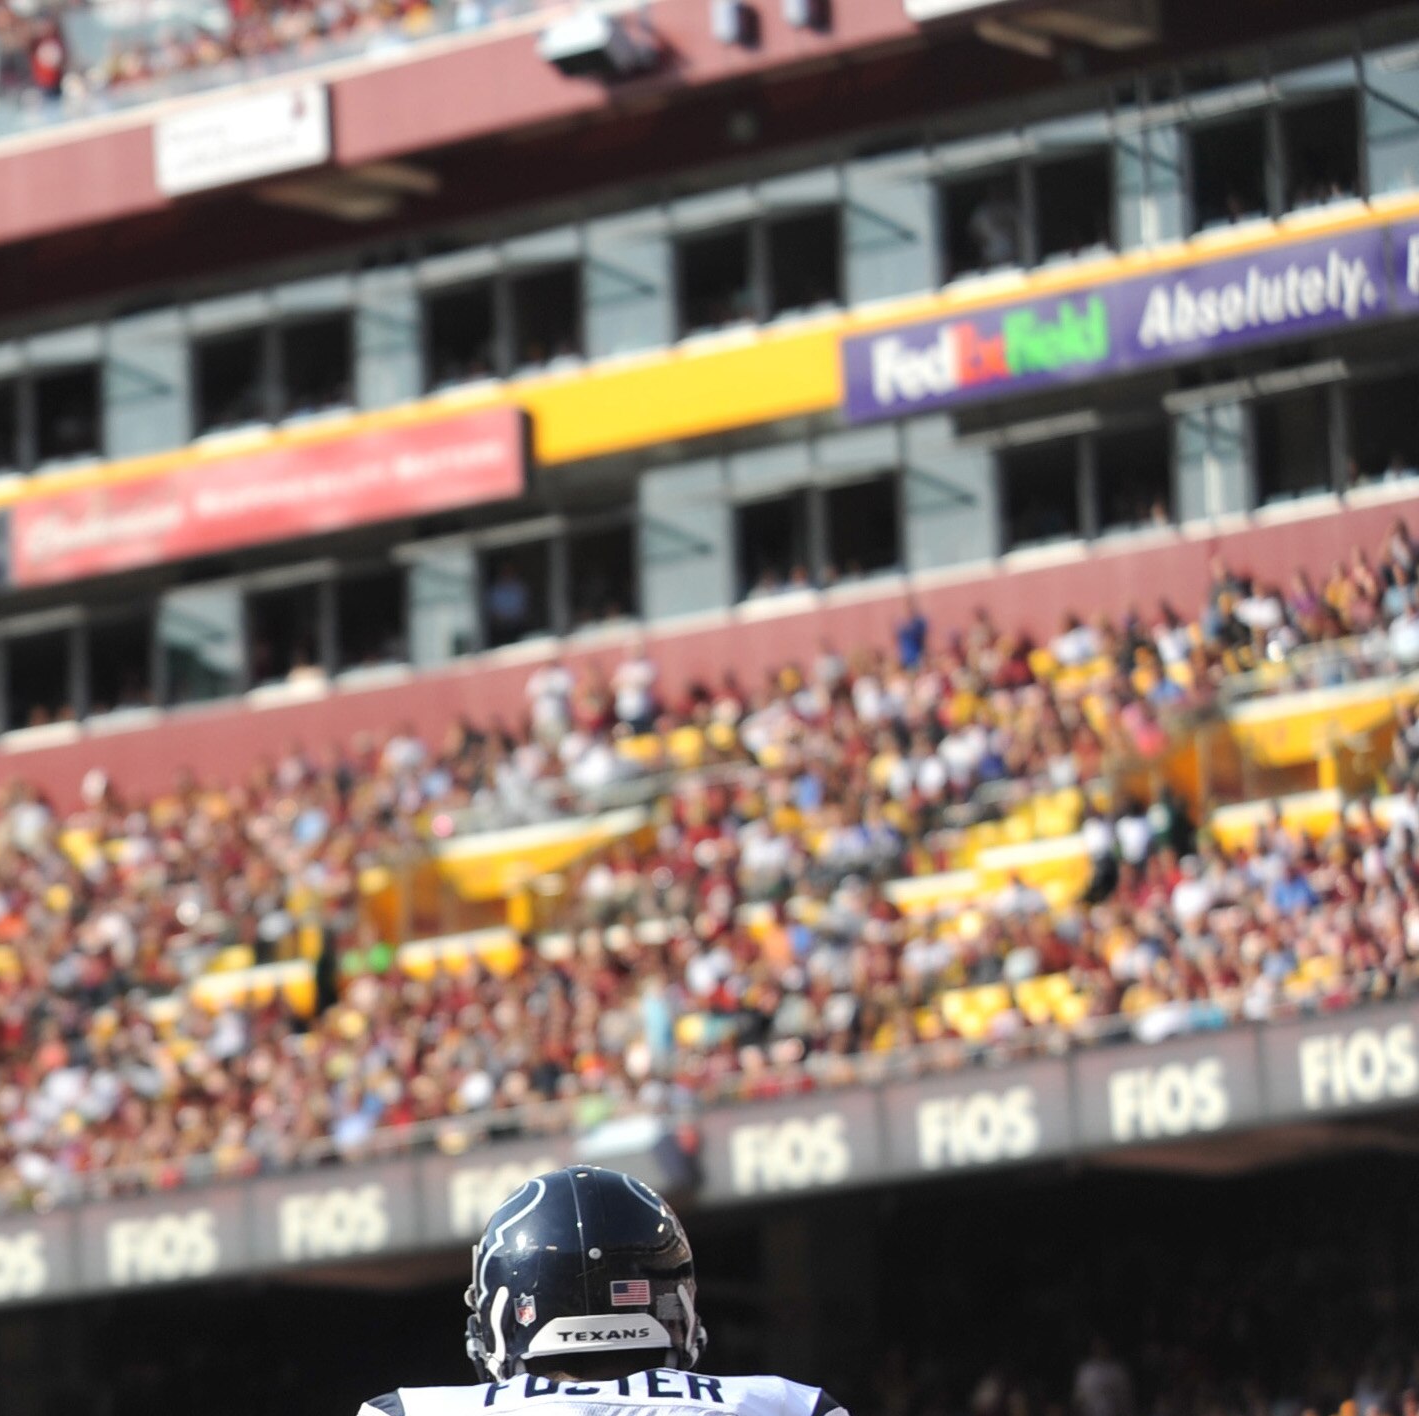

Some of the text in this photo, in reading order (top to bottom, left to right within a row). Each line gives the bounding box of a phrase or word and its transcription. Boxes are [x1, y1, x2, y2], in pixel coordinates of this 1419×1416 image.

[1139, 247, 1377, 349] Absolutely.
[871, 295, 1109, 406] FedExField
[1109, 1057, 1228, 1142] FiOS
[1300, 1023, 1418, 1111] FiOS
[917, 1085, 1039, 1170] FiOS
[106, 1210, 221, 1284] FiOS
[279, 1185, 388, 1257] FiOS
[556, 1326, 650, 1343] TEXANS
